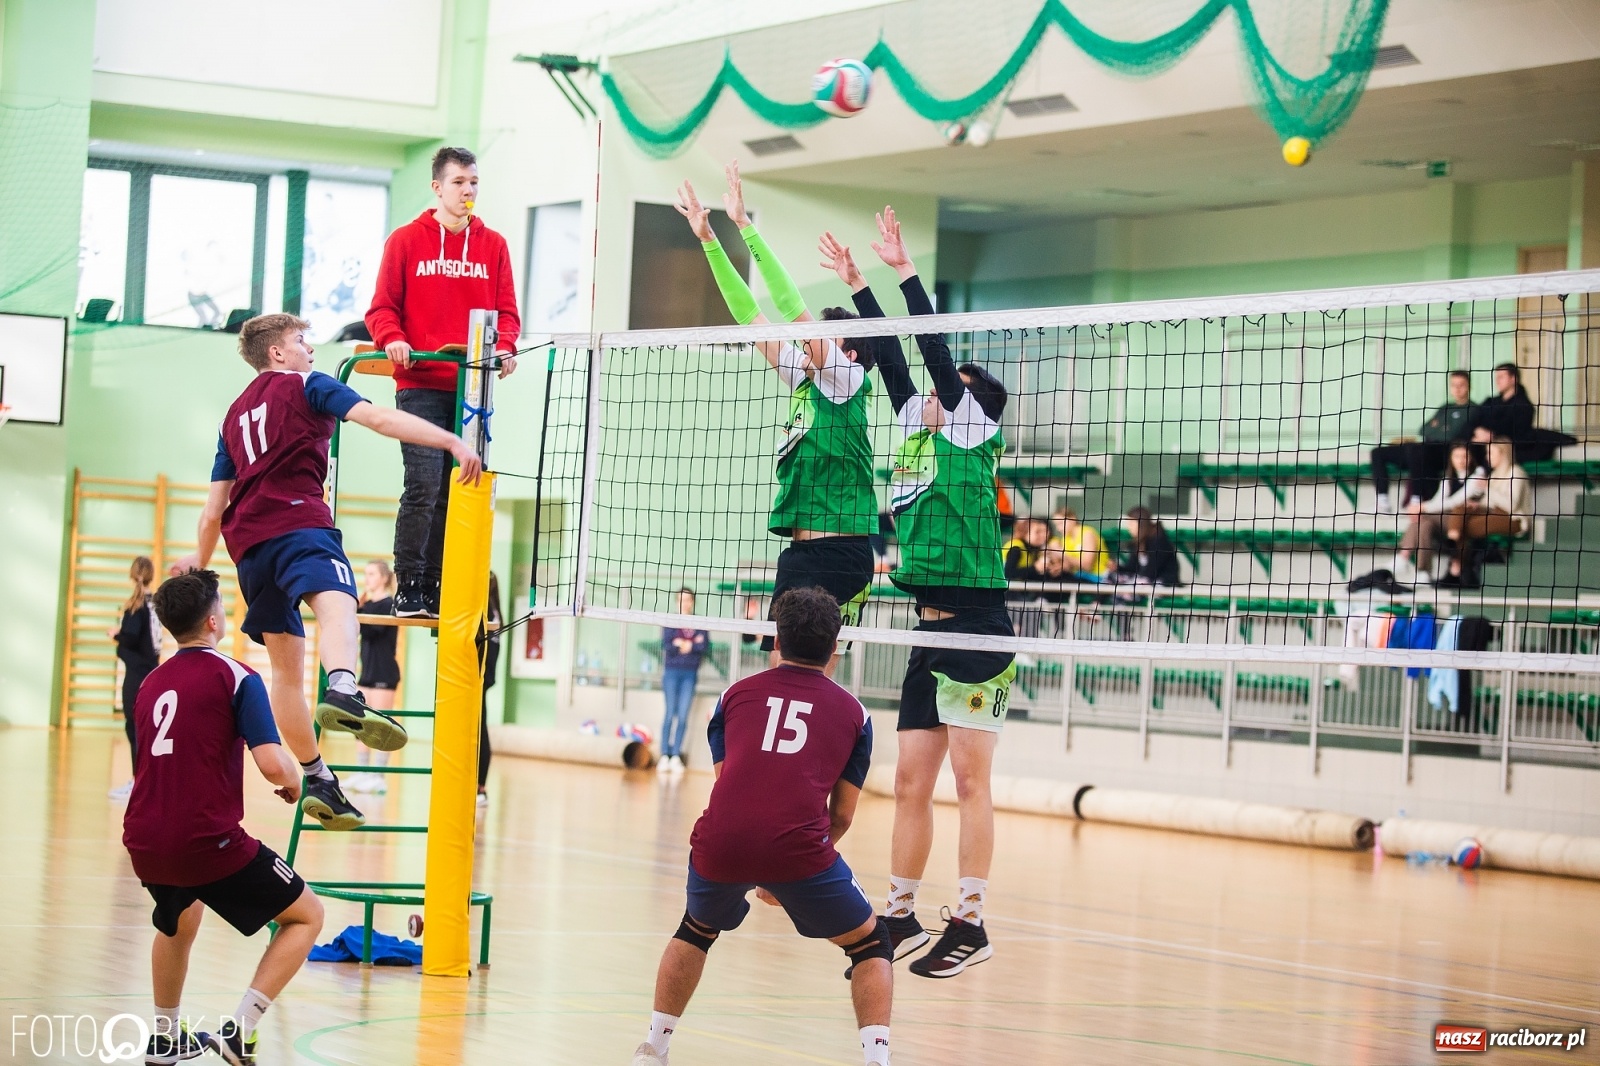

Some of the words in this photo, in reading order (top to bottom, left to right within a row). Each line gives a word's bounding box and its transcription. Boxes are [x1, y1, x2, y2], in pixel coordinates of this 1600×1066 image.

[416, 259, 489, 279] ANTISOCIAL
[239, 401, 268, 466] 17
[331, 558, 352, 586] 17
[151, 689, 178, 757] 2
[761, 696, 814, 754] 15
[272, 857, 294, 885] 10
